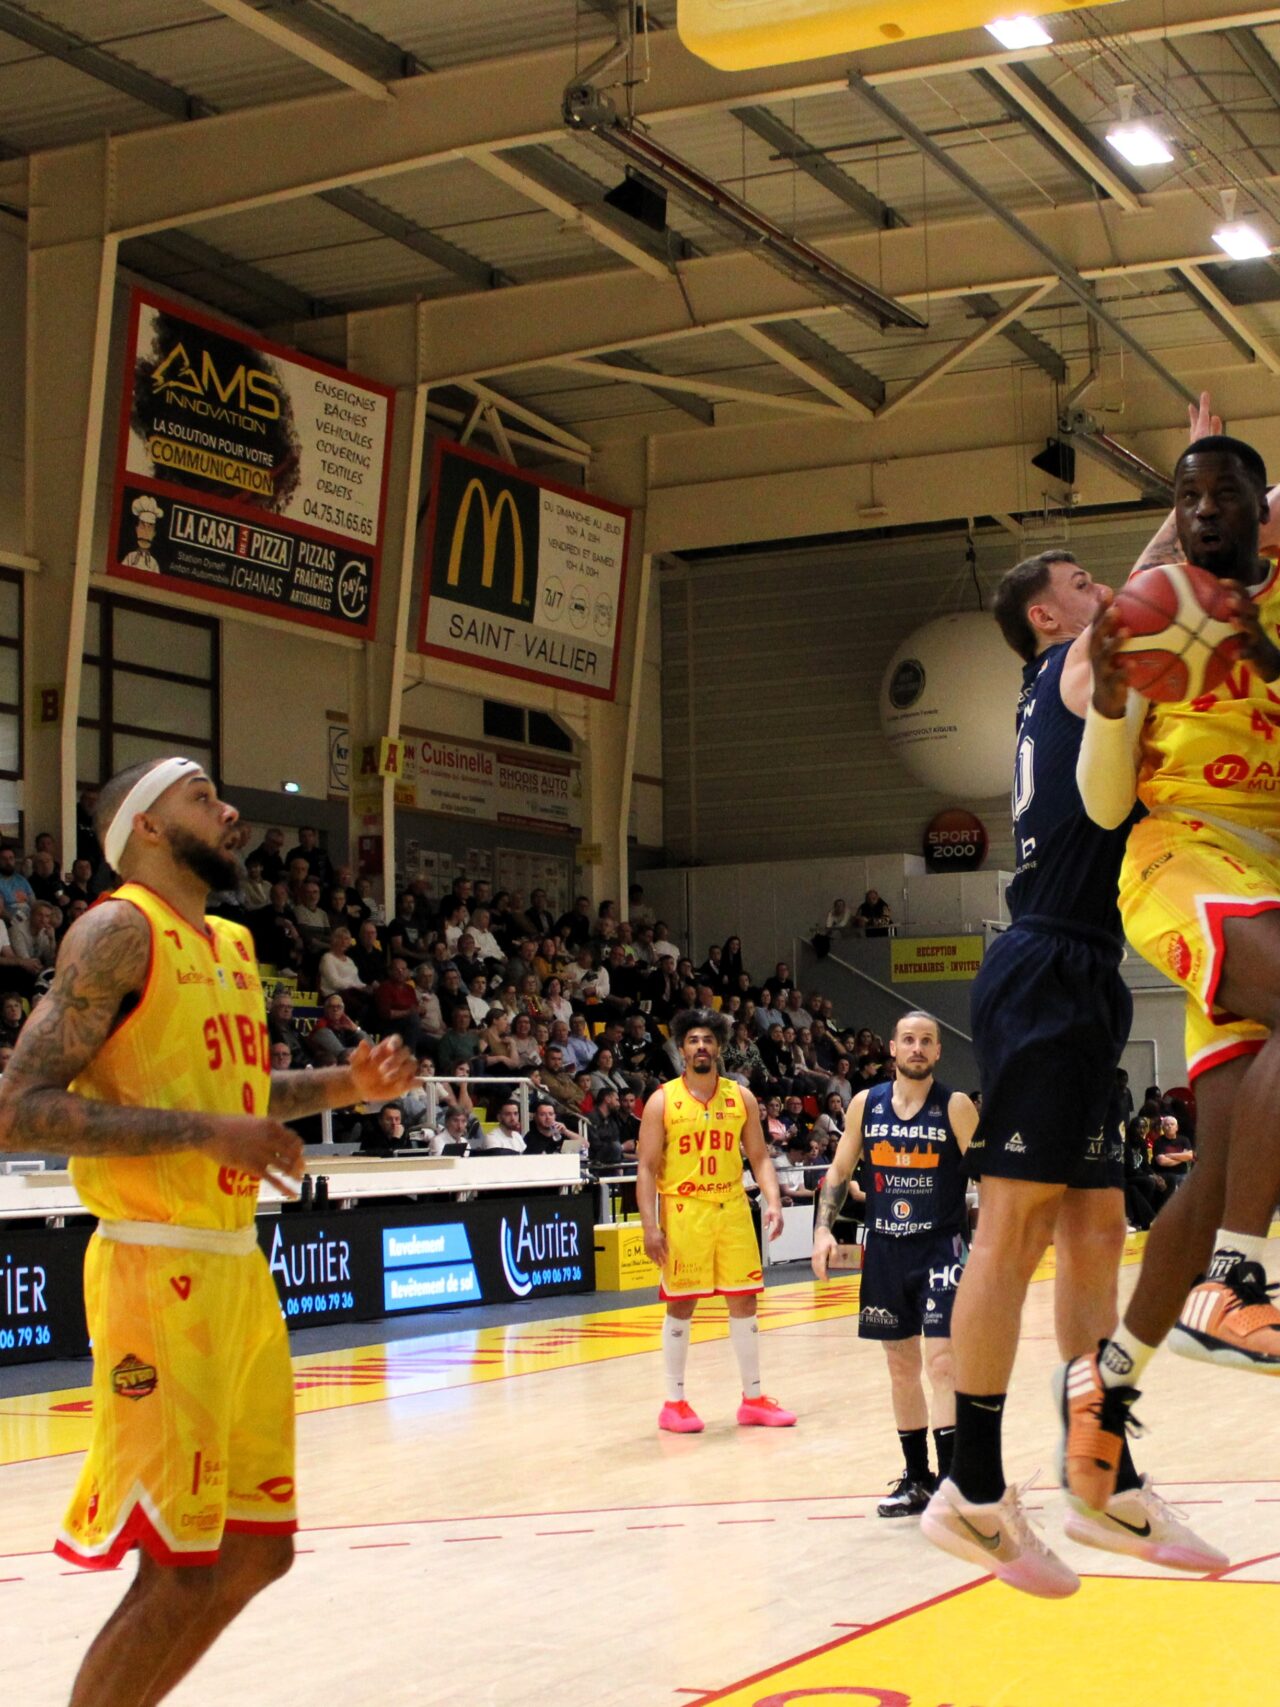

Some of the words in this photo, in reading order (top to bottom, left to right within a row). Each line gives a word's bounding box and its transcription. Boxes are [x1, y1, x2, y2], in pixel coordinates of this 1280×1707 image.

[152, 342, 280, 420] AMS
[314, 380, 376, 412] ENSEIGNES
[165, 388, 267, 435] INNOVATION
[153, 418, 167, 434] LA
[168, 421, 216, 447] SOLUTION
[217, 437, 244, 457] POUR
[245, 446, 274, 467] VOTRE
[316, 440, 371, 469] COVERING
[150, 440, 273, 493] COMMUNICATION
[321, 459, 364, 485] TEXTILES
[303, 498, 374, 537] 04.75.31.65.65
[176, 512, 194, 538] LA
[198, 518, 236, 551] CASA
[250, 532, 288, 568] PIZZA
[298, 541, 336, 572] PIZZAS
[290, 590, 332, 611] ARTISANALES
[448, 613, 516, 653] SAINT
[524, 633, 598, 676] VALLIER
[385, 743, 398, 774] A
[421, 741, 493, 776] Cuisinella
[500, 767, 539, 788] RHODIS
[540, 775, 569, 793] AUTO
[928, 829, 980, 845] SPORT
[933, 845, 976, 858] 2000
[916, 945, 957, 957] RECEPTION
[894, 962, 945, 975] PARTENAIRES
[950, 960, 980, 972] INVITES
[679, 1130, 734, 1154] SVBD
[865, 1124, 888, 1138] LES
[891, 1124, 947, 1142] SABLES
[700, 1156, 717, 1176] 10
[895, 1154, 911, 1166] 18
[885, 1174, 934, 1189] VENDÉE
[875, 1218, 933, 1232] E.Leclerc
[389, 1234, 445, 1258] Ravalement
[390, 1274, 444, 1299] Revêtement
[446, 1272, 459, 1293] de
[461, 1269, 475, 1291] sol
[532, 1270, 541, 1286] 06
[543, 1269, 552, 1285] 99
[552, 1268, 562, 1283] 06
[562, 1267, 571, 1282] 79
[572, 1266, 582, 1281] 36
[287, 1298, 300, 1316] 06
[301, 1297, 313, 1314] 99
[314, 1295, 327, 1313] 06
[328, 1293, 340, 1310] 79
[341, 1291, 354, 1308] 36
[866, 1314, 899, 1326] PRESTIGES
[17, 1326, 33, 1347] 79
[35, 1325, 51, 1346] 36
